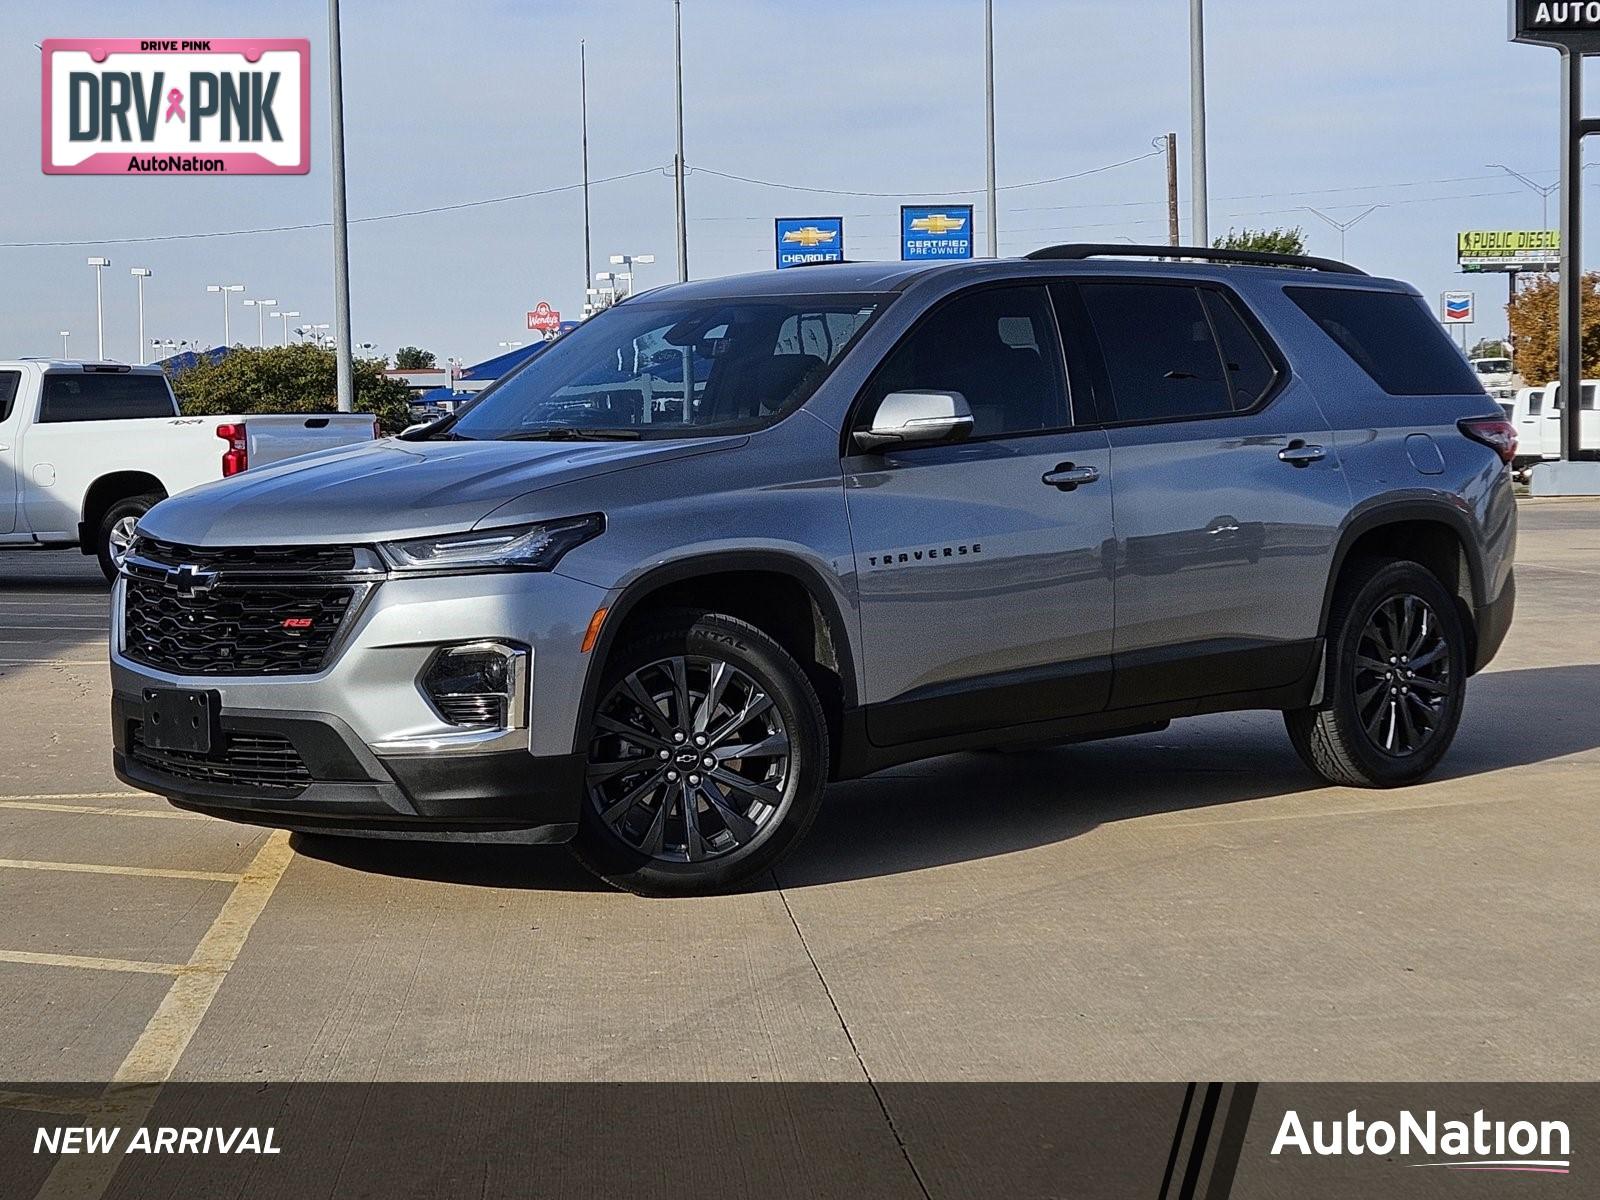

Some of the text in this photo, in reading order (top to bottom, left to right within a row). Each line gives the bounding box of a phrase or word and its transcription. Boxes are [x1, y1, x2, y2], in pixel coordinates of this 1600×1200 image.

[1534, 2, 1600, 23] AUTO
[907, 239, 968, 248] CERTIFIED
[1473, 231, 1556, 248] PUBLIC DIESEL
[910, 247, 965, 255] PRE-OWNED
[782, 253, 838, 263] CHEVROLET
[529, 313, 558, 327] Wendy's
[868, 544, 982, 566] TRAVERSE
[283, 618, 312, 627] RS
